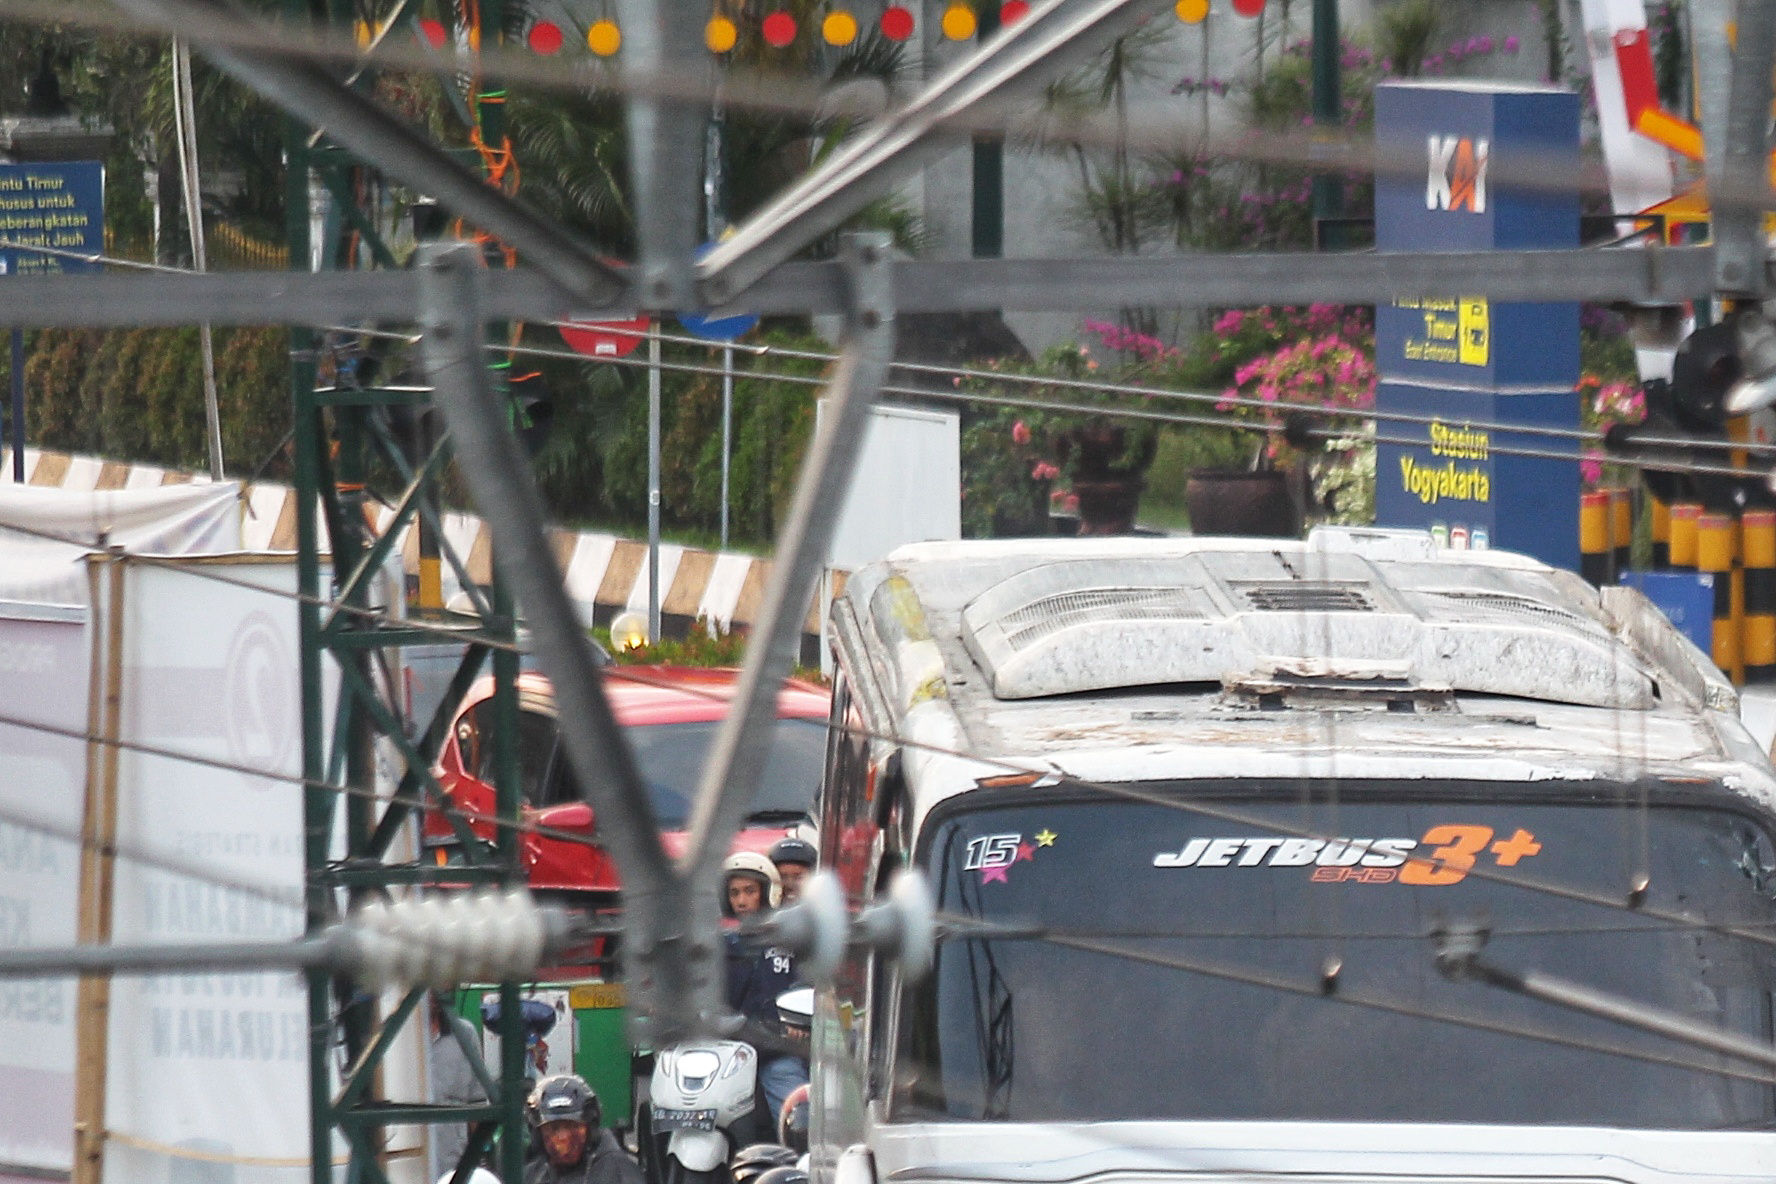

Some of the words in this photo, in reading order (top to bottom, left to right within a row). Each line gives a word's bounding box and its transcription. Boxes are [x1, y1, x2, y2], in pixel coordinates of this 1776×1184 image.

[1427, 135, 1489, 214] KAI
[38, 193, 75, 208] untuk
[53, 231, 84, 246] Jauh
[1424, 313, 1457, 340] Timur
[1431, 419, 1488, 461] Stasiun
[1400, 455, 1489, 504] Yogyakarta
[964, 834, 1022, 871] 15
[1152, 838, 1418, 868] JETBUS
[1309, 867, 1399, 884] SHD
[773, 957, 790, 974] 94
